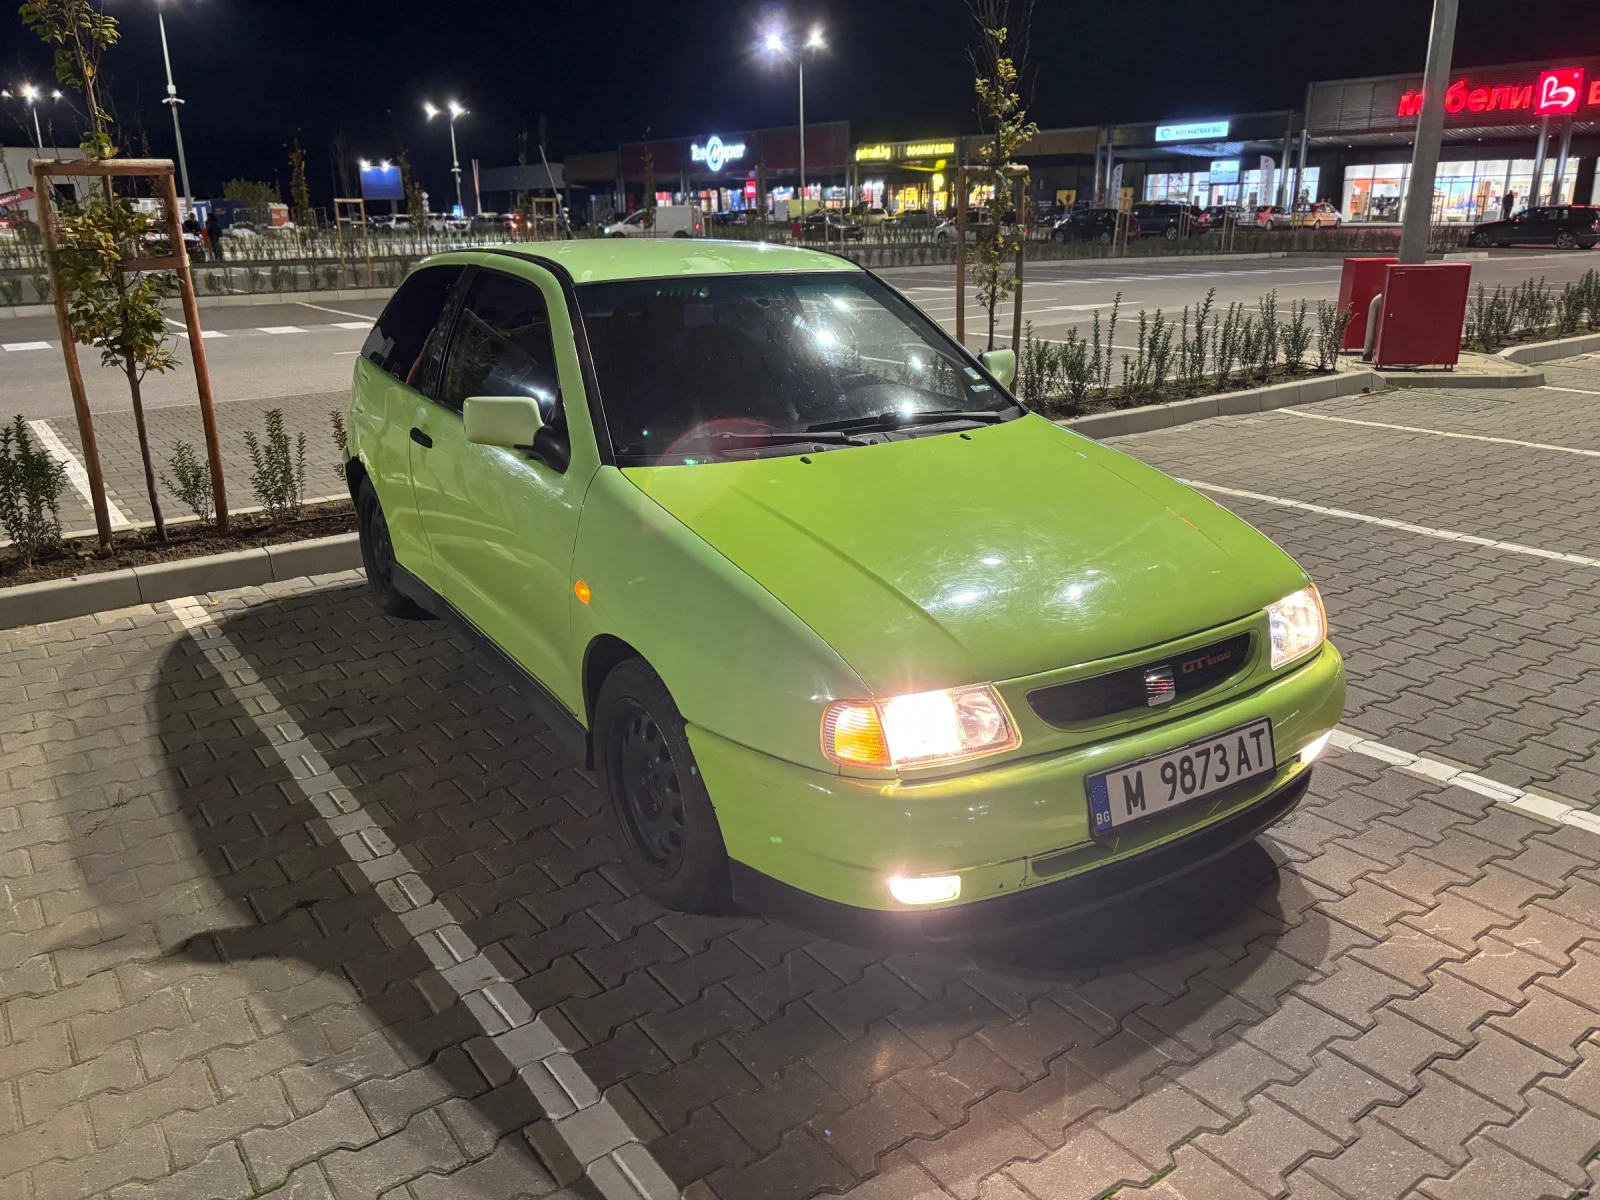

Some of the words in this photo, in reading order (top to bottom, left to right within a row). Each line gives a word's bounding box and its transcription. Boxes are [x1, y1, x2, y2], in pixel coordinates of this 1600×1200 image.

[1398, 80, 1532, 116] мбели
[1175, 126, 1221, 136] NOVMATRAK.BG
[1122, 770, 1146, 815] M
[1160, 743, 1230, 801] 9873
[1236, 727, 1265, 776] AT
[1096, 811, 1110, 825] BG
